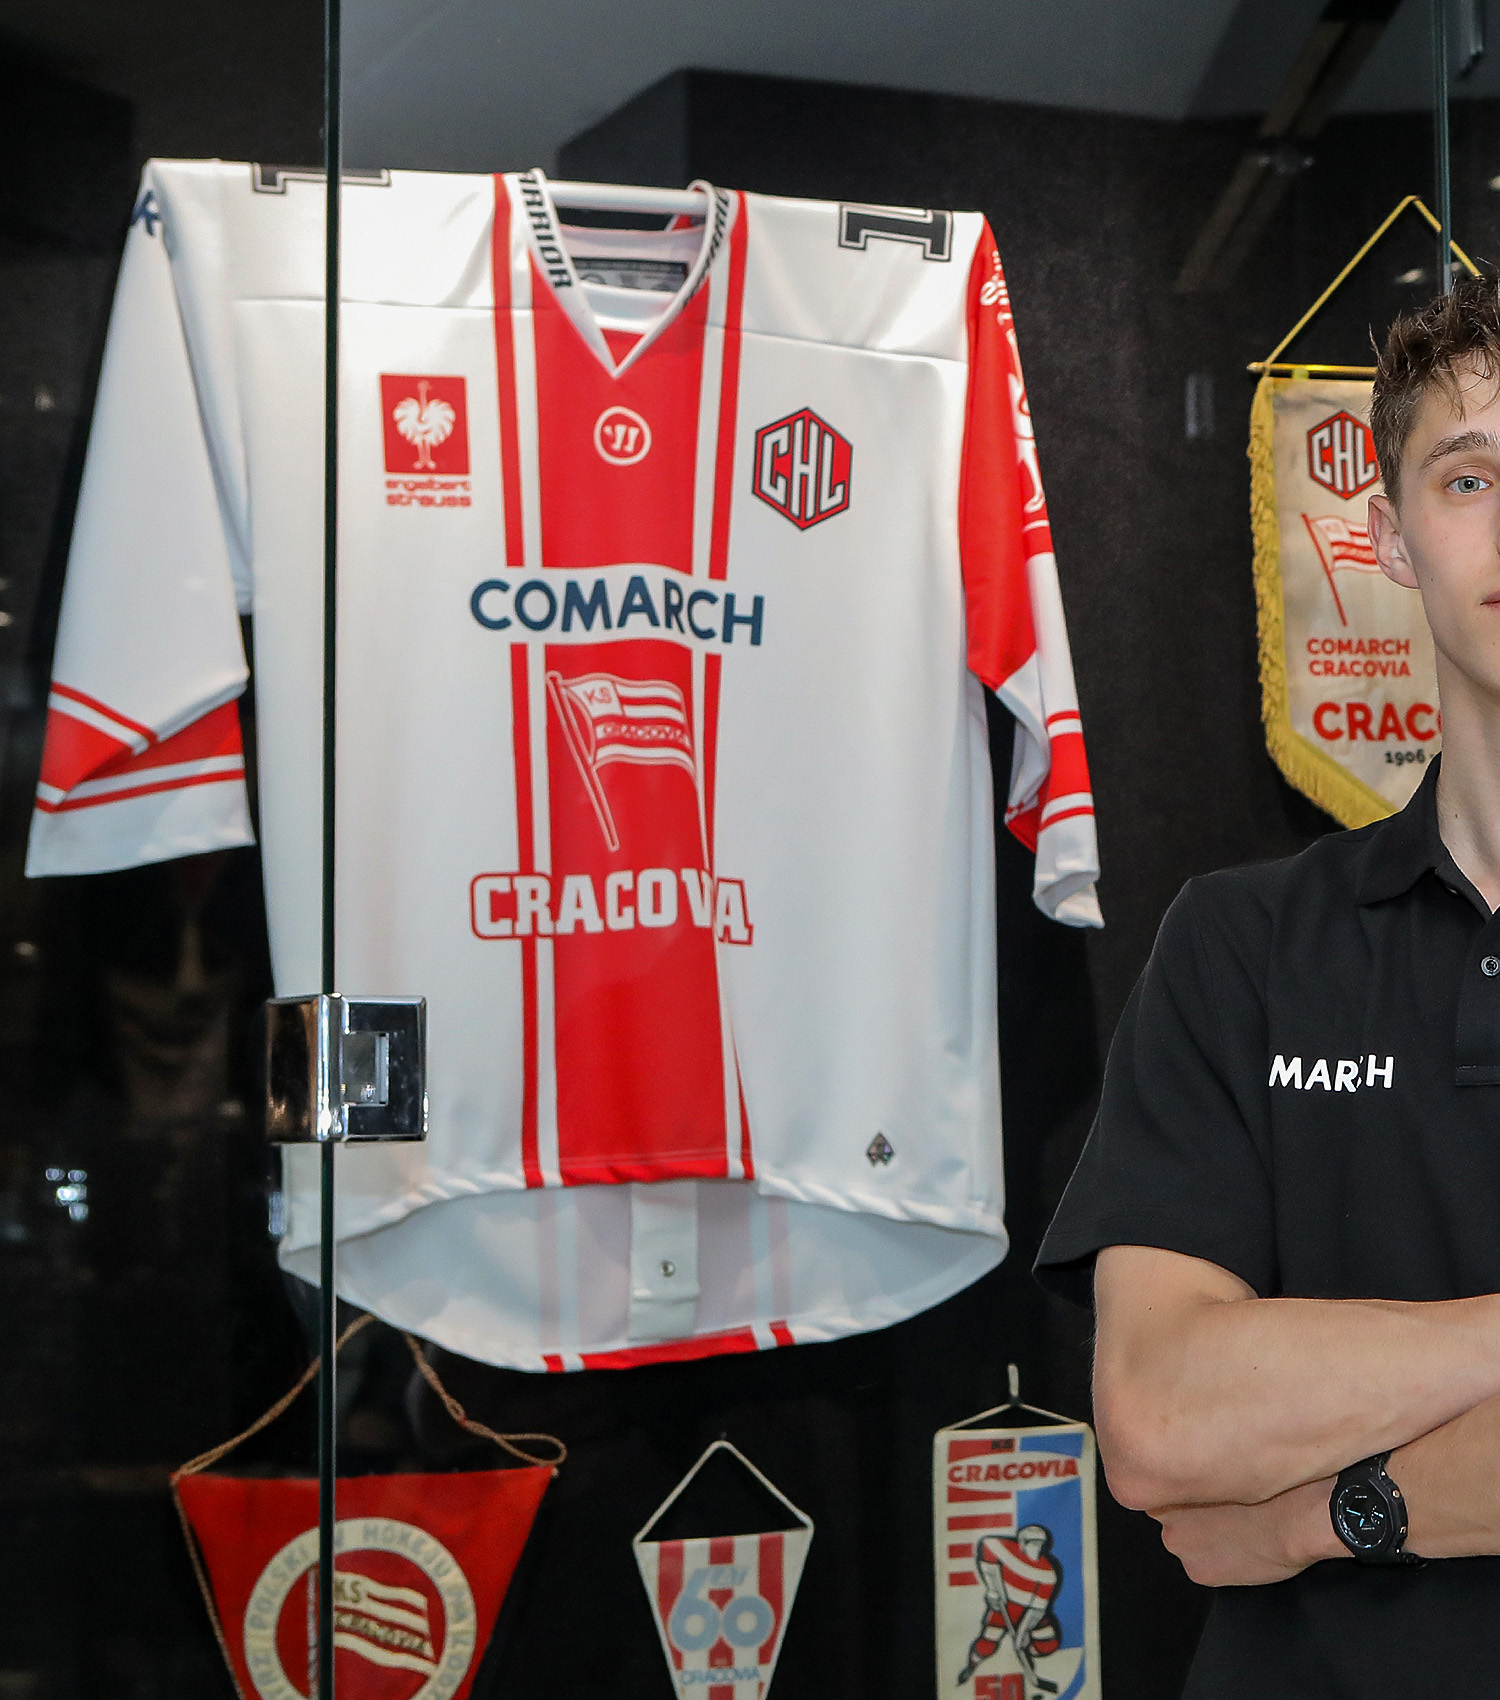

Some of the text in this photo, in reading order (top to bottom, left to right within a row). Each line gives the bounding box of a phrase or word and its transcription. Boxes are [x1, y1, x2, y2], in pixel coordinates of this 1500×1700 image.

[760, 417, 848, 524] CHL
[1311, 419, 1377, 493] CHL
[470, 575, 765, 646] COMARCH
[1306, 637, 1411, 657] COMARCH
[1308, 660, 1412, 678] CRACOVIA
[1313, 701, 1443, 742] CRAC
[471, 867, 753, 946] CRACOVA
[948, 1458, 1080, 1484] CRACOVIA
